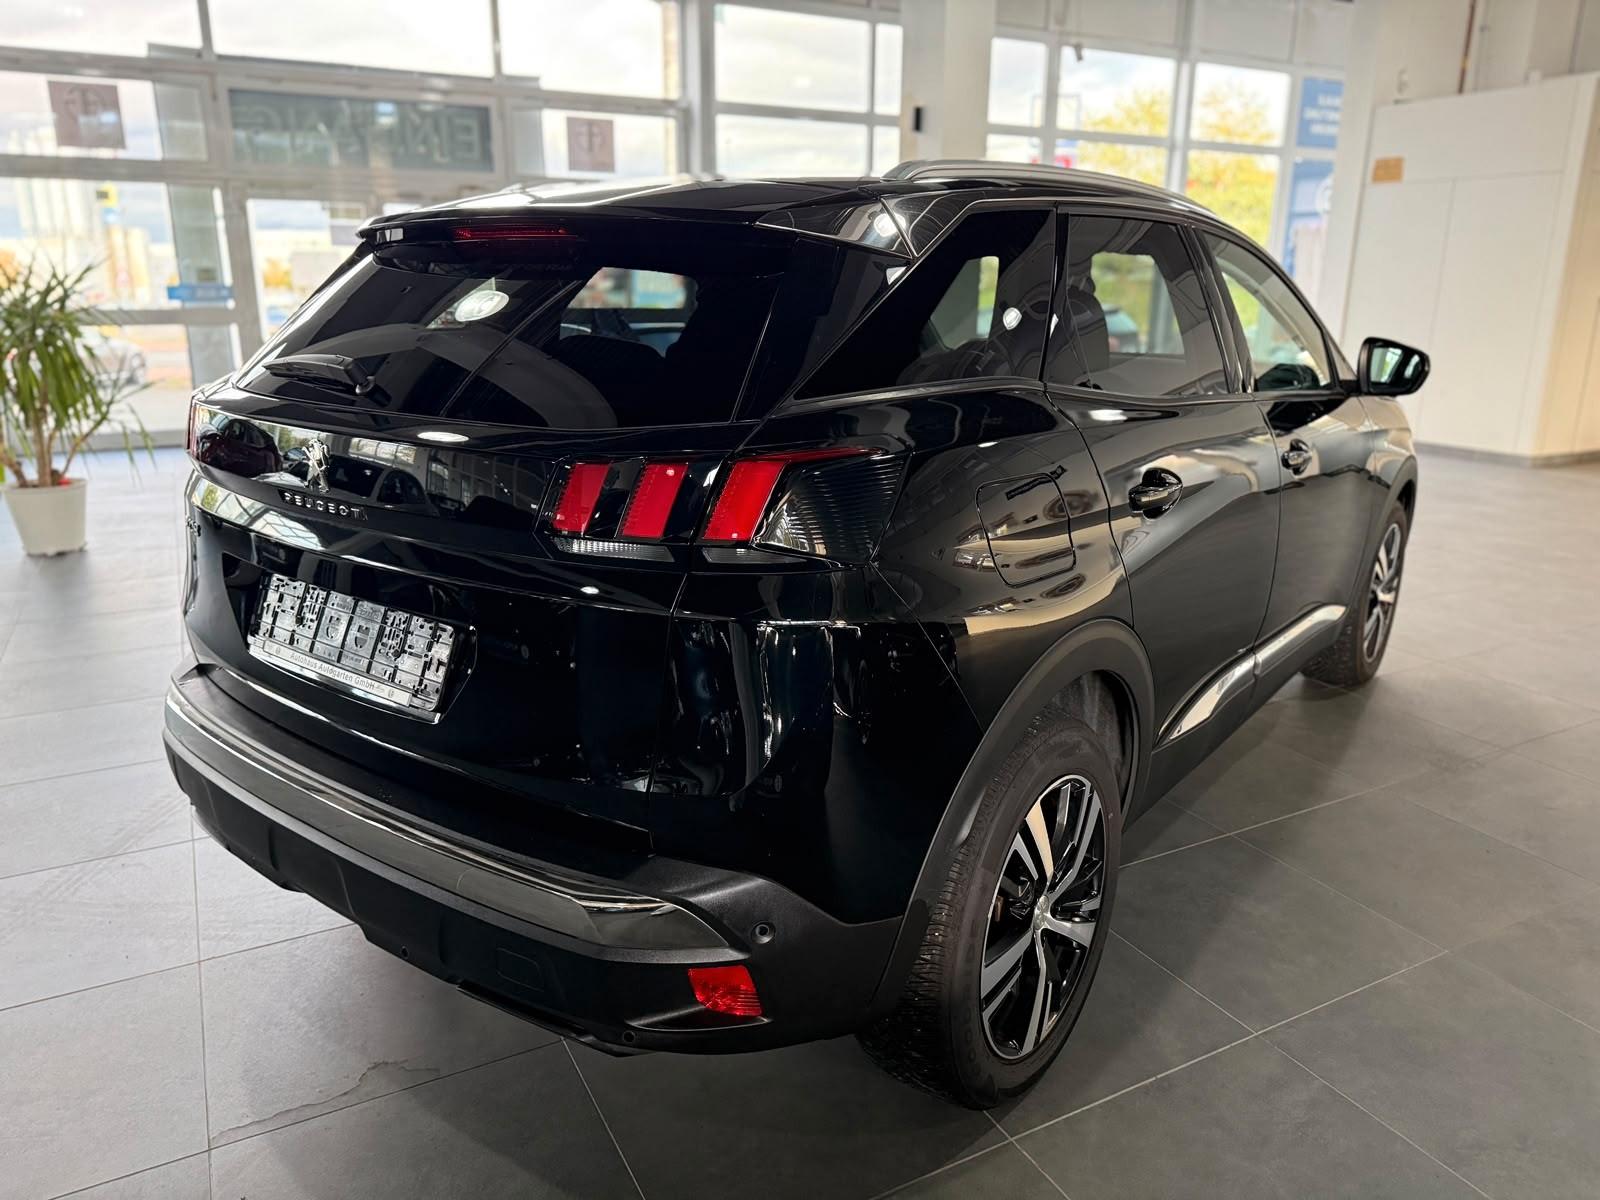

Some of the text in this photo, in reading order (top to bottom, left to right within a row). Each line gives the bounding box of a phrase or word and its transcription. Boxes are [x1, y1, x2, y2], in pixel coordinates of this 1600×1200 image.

[283, 492, 361, 519] PEUGEOT
[290, 652, 318, 670] Autohaus
[354, 677, 376, 690] GmbH
